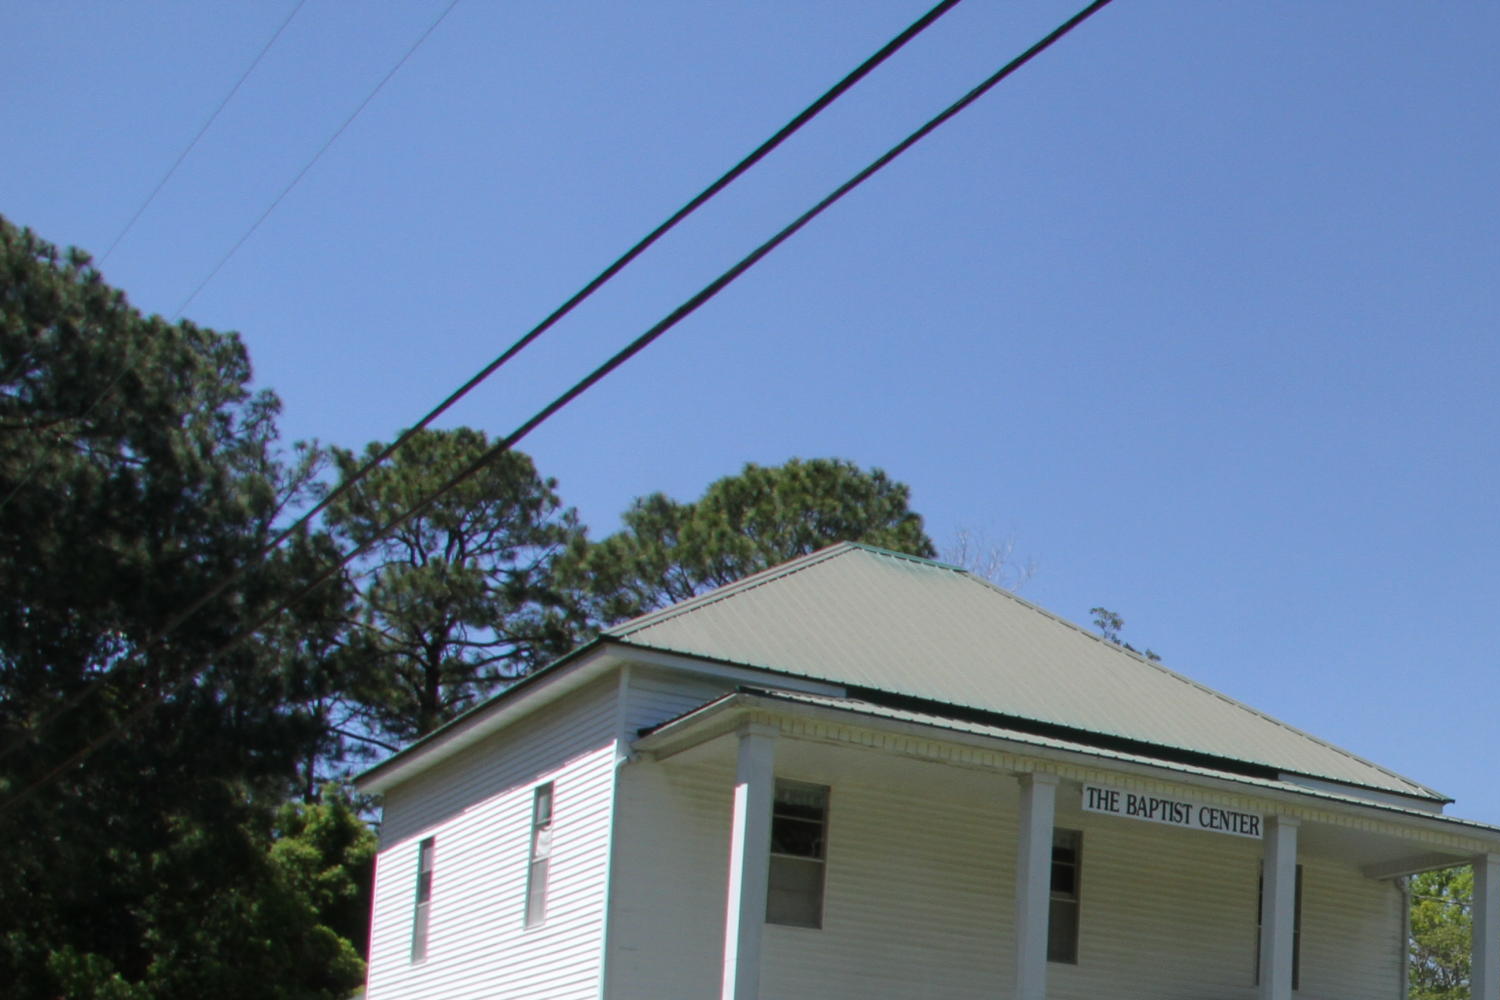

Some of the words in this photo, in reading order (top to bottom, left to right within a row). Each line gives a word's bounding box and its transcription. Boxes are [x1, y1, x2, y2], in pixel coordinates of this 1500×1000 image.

[1086, 787, 1121, 813] THE
[1126, 794, 1193, 824] BAPTIST
[1198, 806, 1260, 836] CENTER
